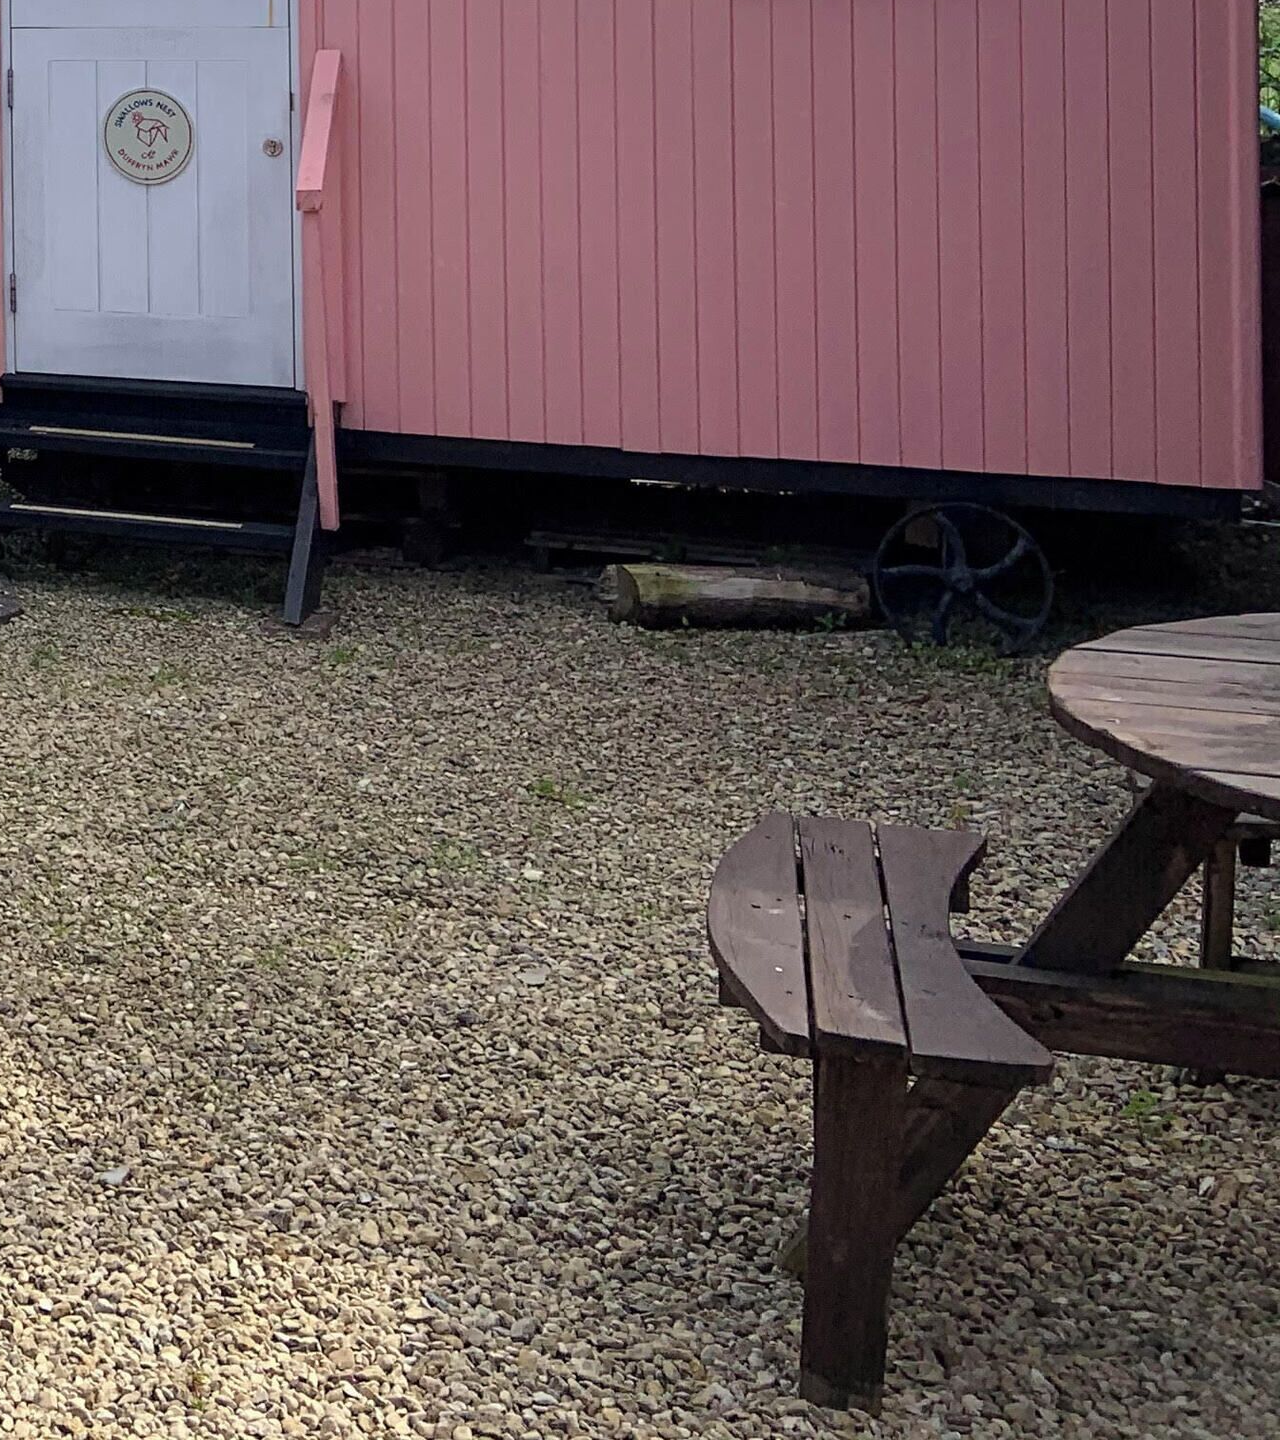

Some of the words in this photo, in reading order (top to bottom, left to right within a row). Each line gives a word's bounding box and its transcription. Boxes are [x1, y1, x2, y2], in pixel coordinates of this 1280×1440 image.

[114, 99, 153, 128] SWALLOWS
[156, 101, 177, 118] NEST
[118, 148, 153, 170] DUFFRYN
[156, 149, 179, 170] MAWR
